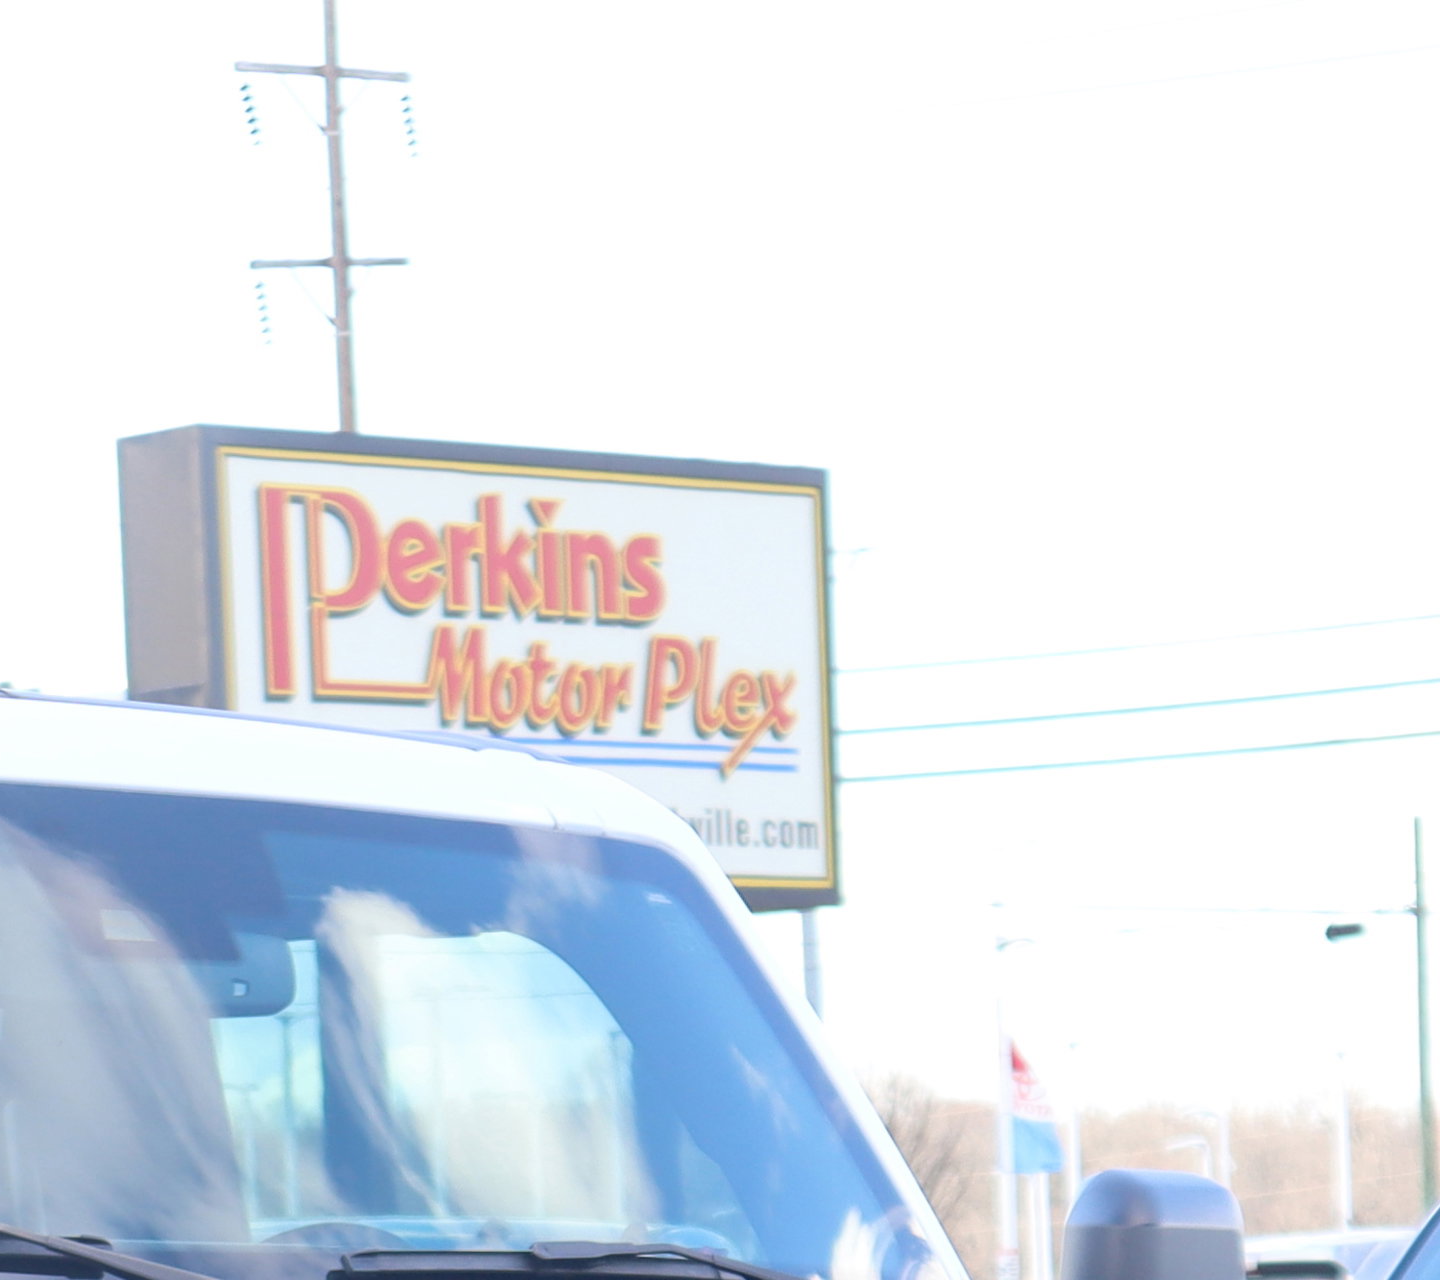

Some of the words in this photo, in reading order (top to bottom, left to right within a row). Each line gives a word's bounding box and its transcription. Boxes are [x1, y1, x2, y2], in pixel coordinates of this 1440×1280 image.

[256, 482, 668, 702] Perkins
[425, 623, 634, 737] Motor
[642, 634, 800, 778] Plex
[671, 807, 820, 849] ville.com
